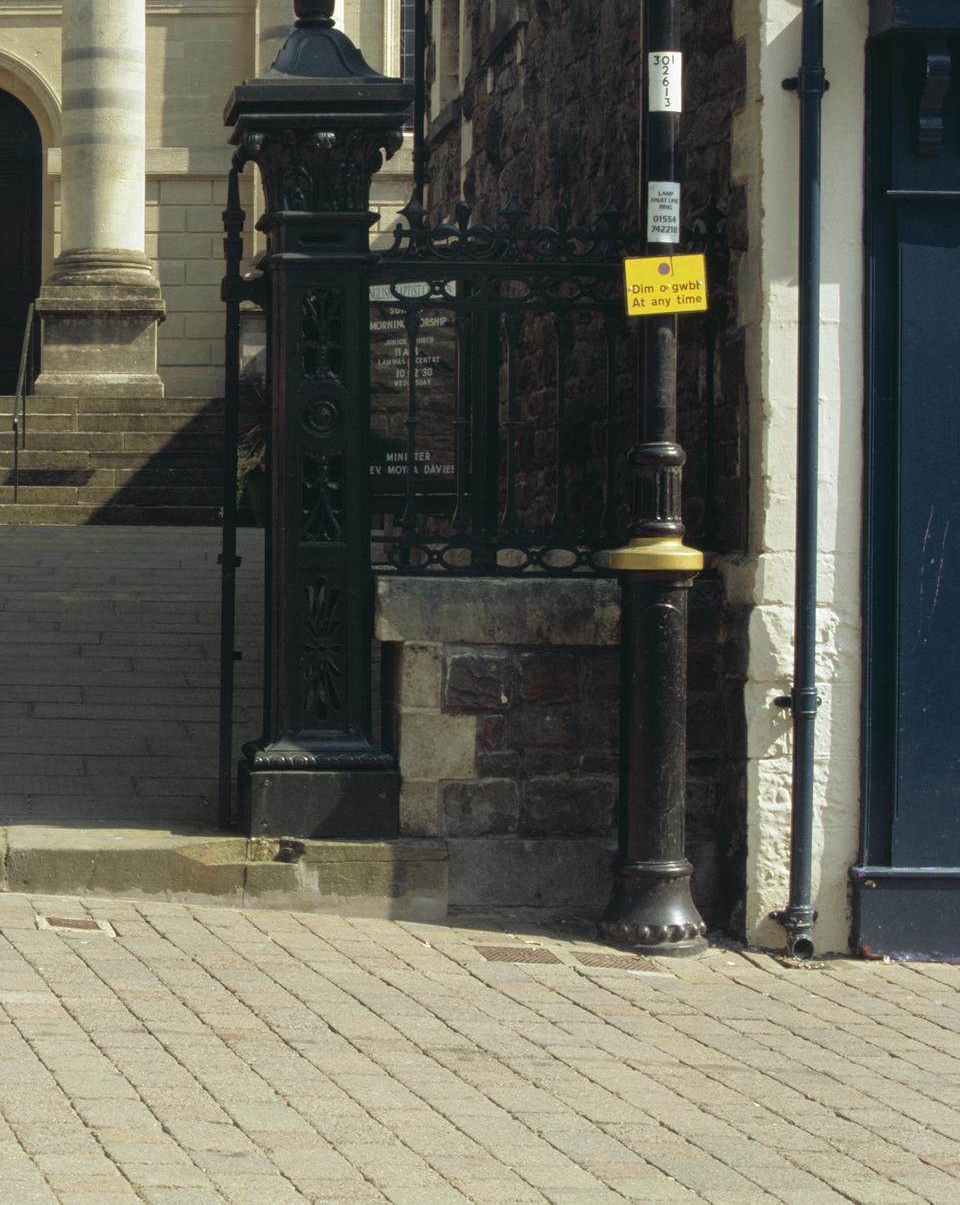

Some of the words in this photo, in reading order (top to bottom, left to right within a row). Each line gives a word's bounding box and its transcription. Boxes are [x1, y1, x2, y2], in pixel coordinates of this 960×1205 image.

[652, 215, 677, 224] 01554
[631, 283, 655, 294] Dim
[631, 297, 646, 308] At
[651, 297, 671, 308] any
[676, 294, 702, 305] time
[369, 319, 407, 331] MORNIN
[418, 315, 448, 329] ORSHIP
[385, 451, 431, 462] MINITER
